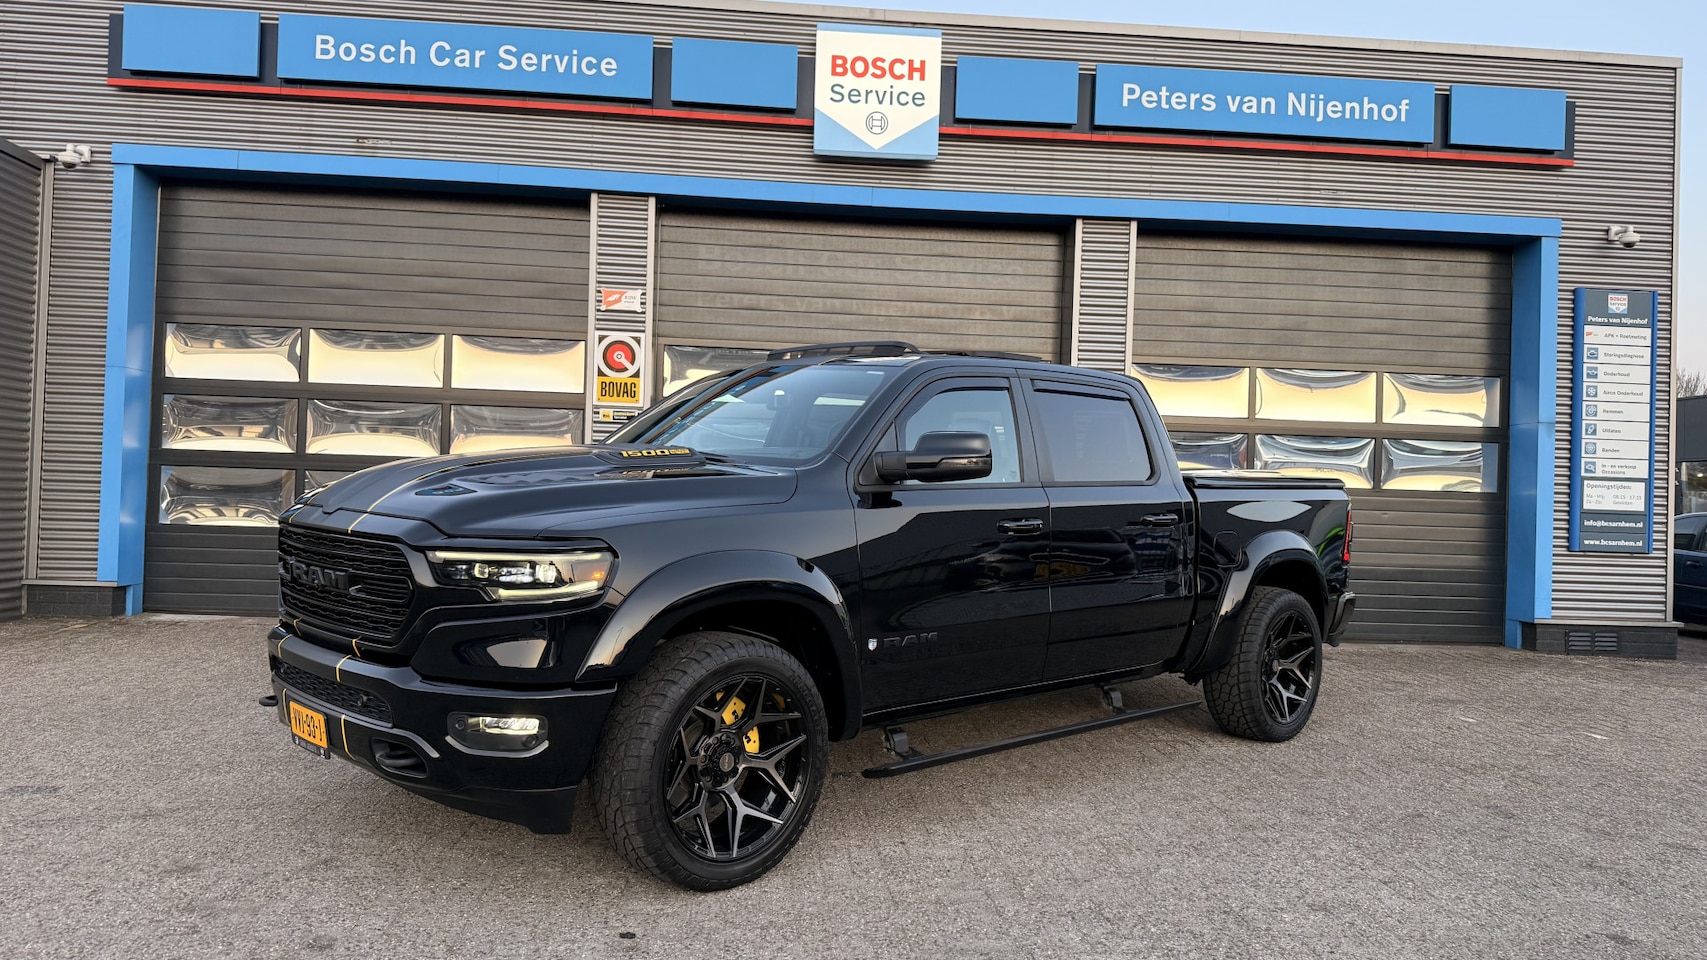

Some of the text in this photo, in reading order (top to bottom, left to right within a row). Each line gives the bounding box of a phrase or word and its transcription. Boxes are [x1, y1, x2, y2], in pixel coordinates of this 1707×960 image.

[315, 34, 619, 77] Bosch Car Service
[831, 55, 926, 81] BOSCH
[830, 83, 926, 107] Service
[1122, 83, 1410, 122] Peters van Nijenhof
[1587, 315, 1608, 323] Peters
[1621, 317, 1648, 325] Nijenhof
[600, 381, 637, 398] BOVAG
[621, 448, 670, 457] 1500
[1584, 520, 1643, 528] info@bcsarnhem.nl
[1583, 539, 1643, 547] www.bcsarnhem.nl
[291, 561, 348, 590] RAM
[883, 632, 938, 649] RAM
